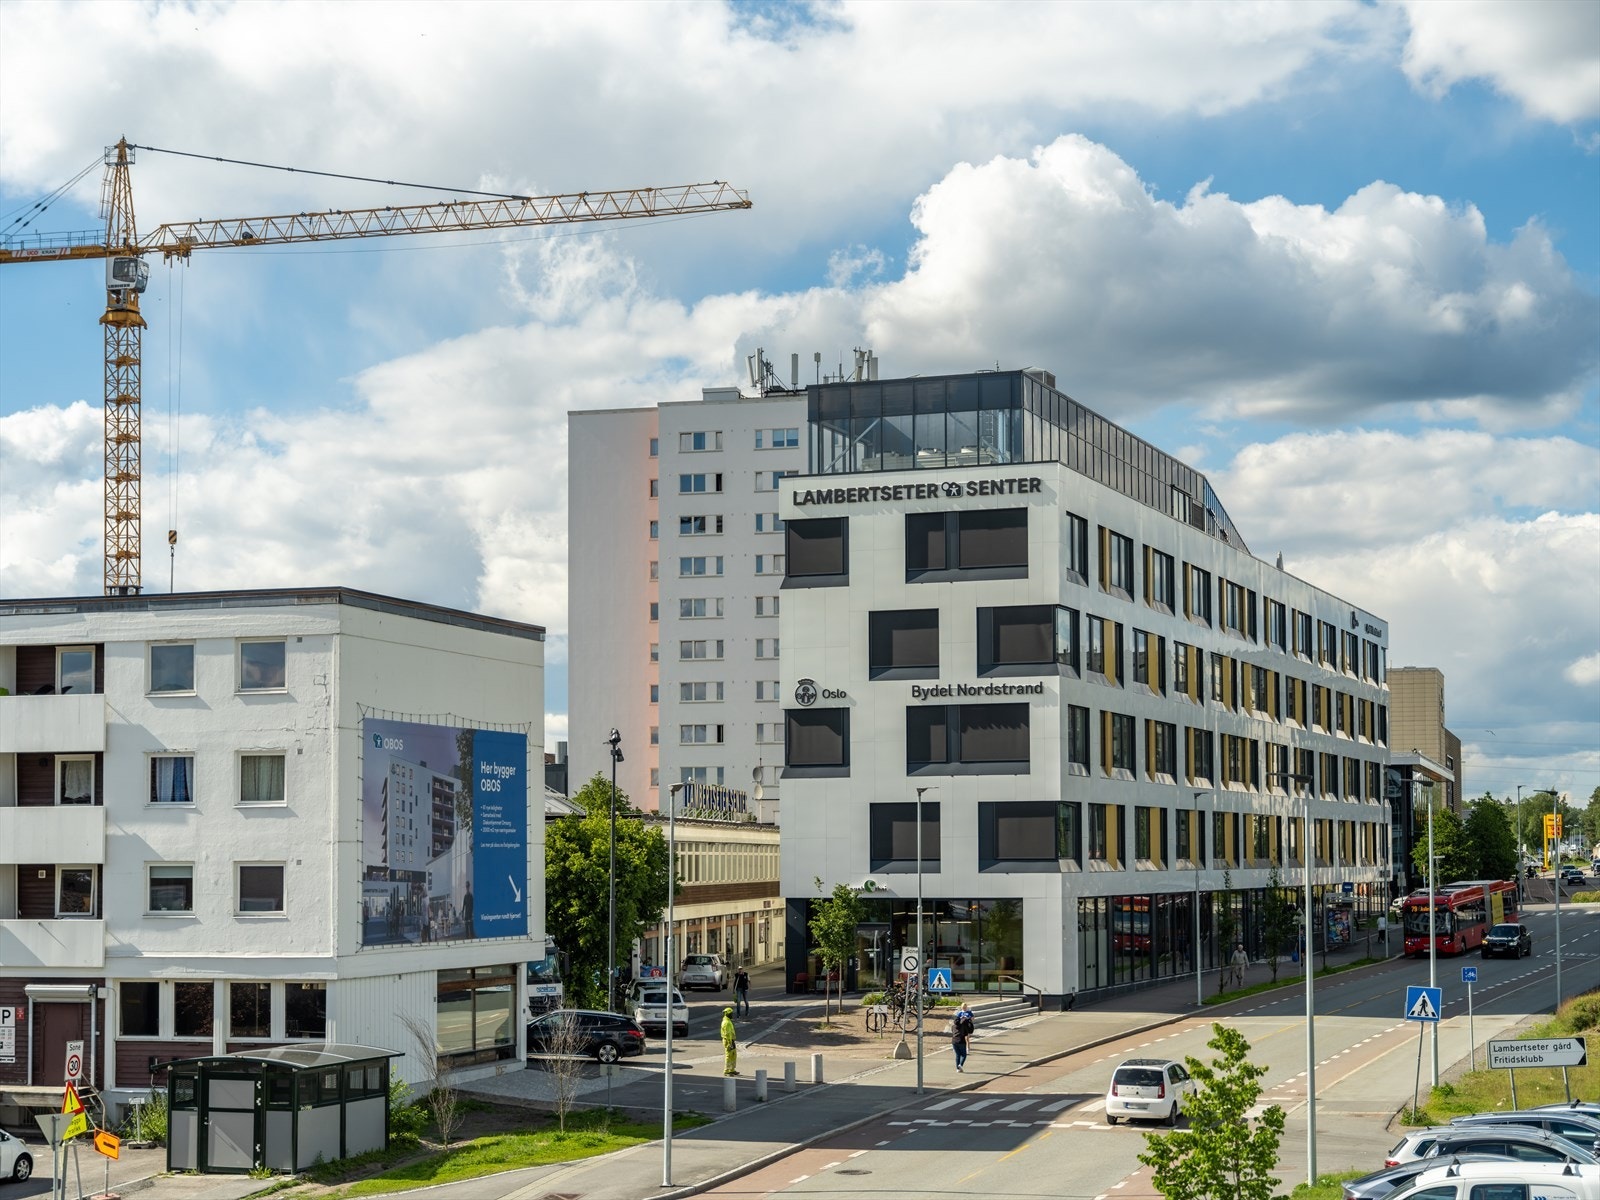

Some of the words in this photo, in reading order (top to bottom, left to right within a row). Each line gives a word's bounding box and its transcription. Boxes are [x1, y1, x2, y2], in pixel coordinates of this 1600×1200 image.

[793, 483, 939, 506] LAMBERTSETER
[966, 477, 1042, 496] SENTER
[822, 688, 847, 699] Oslo
[911, 683, 952, 701] Bydel
[957, 681, 1043, 697] Nordstrand
[383, 738, 404, 751] OBOS
[480, 761, 492, 774] Her
[493, 761, 516, 779] bygger
[480, 779, 501, 792] OBOS
[2, 1009, 12, 1025] P
[69, 1043, 81, 1052] Sone
[1493, 1044, 1549, 1053] Lambertseter
[1553, 1042, 1572, 1052] gård
[70, 1060, 79, 1072] 30
[1494, 1055, 1544, 1064] Fritidsklubb
